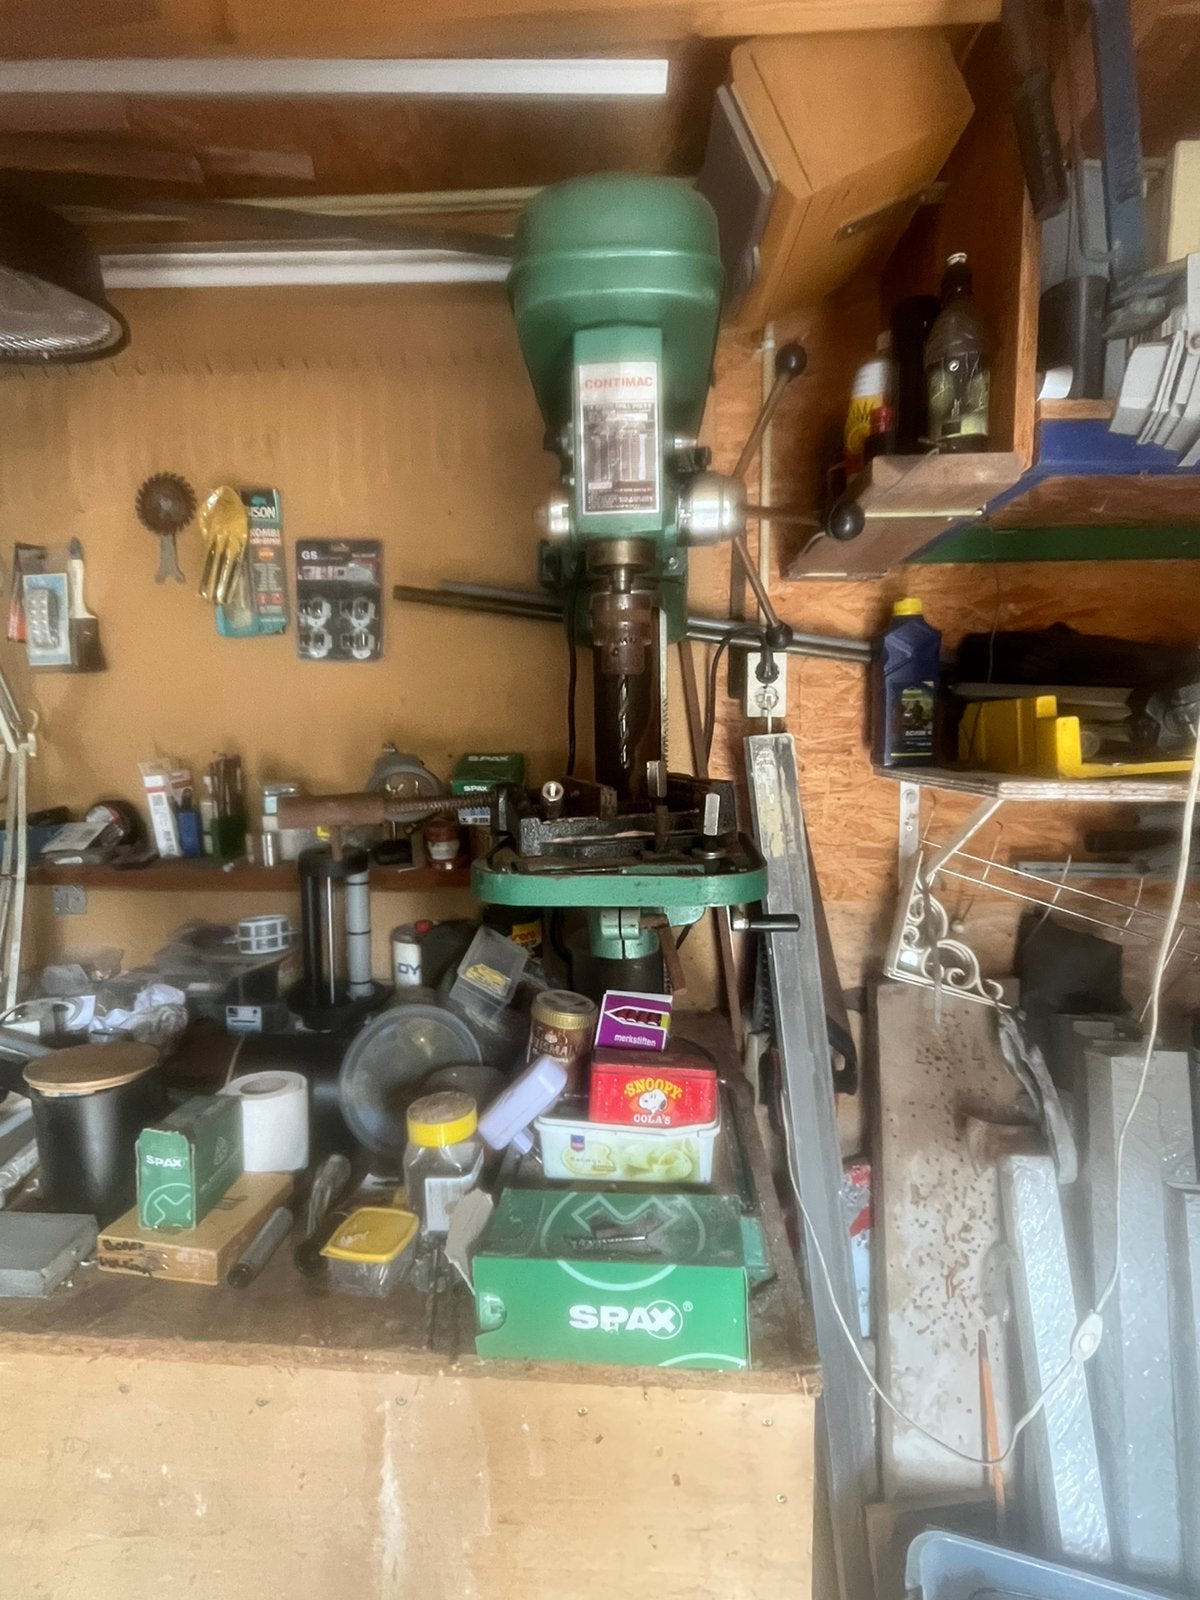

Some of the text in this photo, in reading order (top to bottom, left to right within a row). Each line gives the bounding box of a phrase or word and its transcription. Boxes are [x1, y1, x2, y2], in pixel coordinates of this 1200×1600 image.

[584, 376, 653, 389] CONTIMAC
[301, 550, 318, 560] GS
[614, 1034, 656, 1047] merkstiften
[624, 1077, 682, 1100] SNOOPY
[146, 1154, 184, 1169] SPAX
